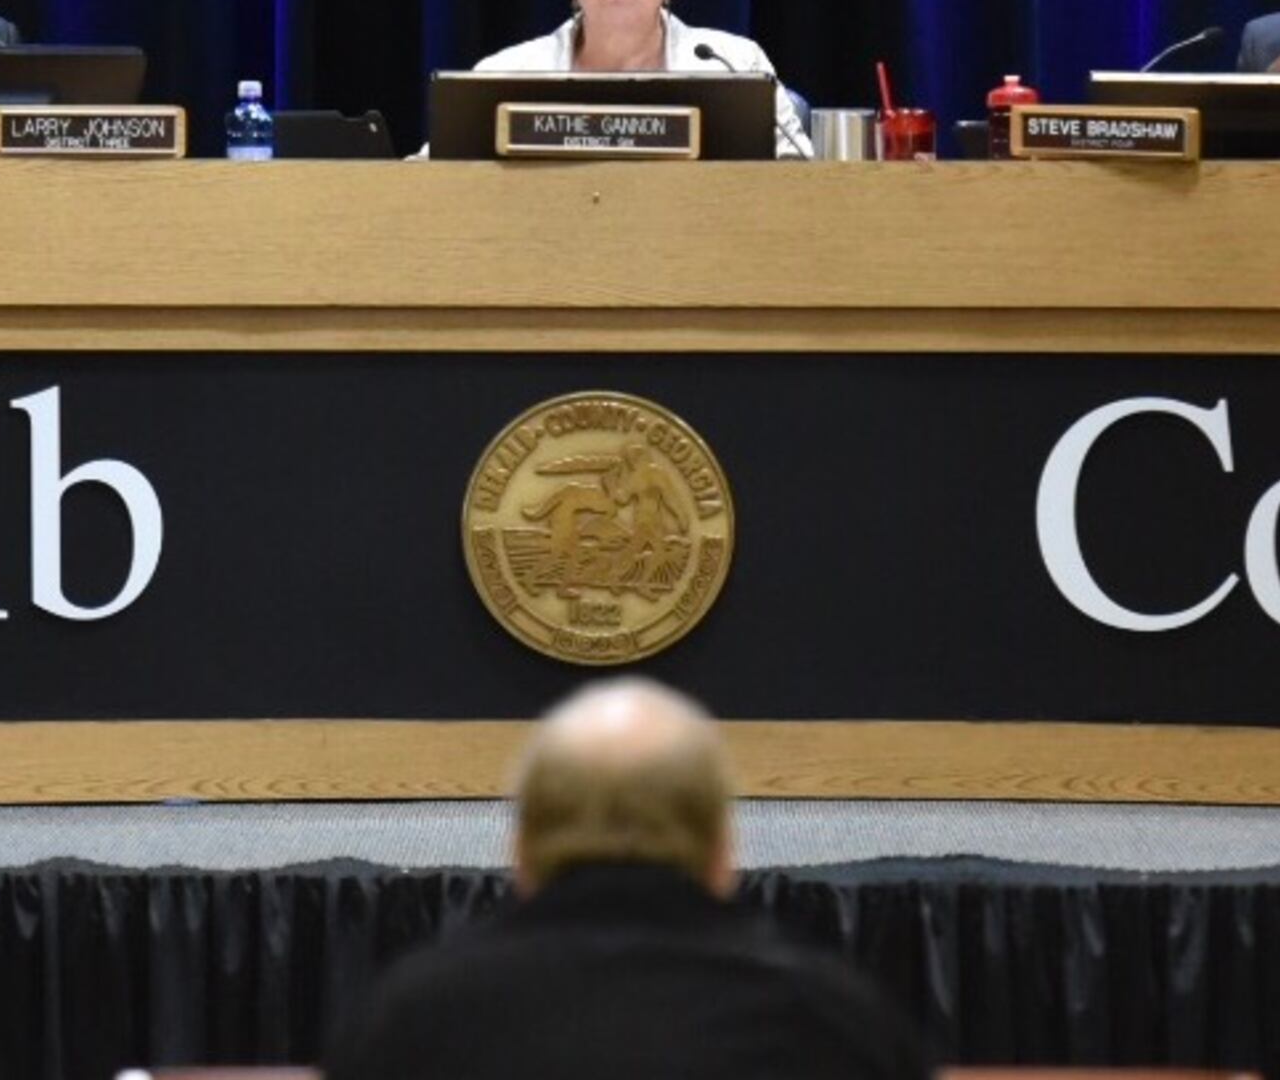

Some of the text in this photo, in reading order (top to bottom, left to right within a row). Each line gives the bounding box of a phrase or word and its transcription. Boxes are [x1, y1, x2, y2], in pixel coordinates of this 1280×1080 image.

[11, 118, 165, 137] LARRY JOHNSON
[534, 115, 666, 135] KATHIE GANNON
[1028, 118, 1178, 139] STEVE BRADSHAW
[45, 137, 90, 149] DISTRICT
[563, 136, 611, 148] DISTRICT
